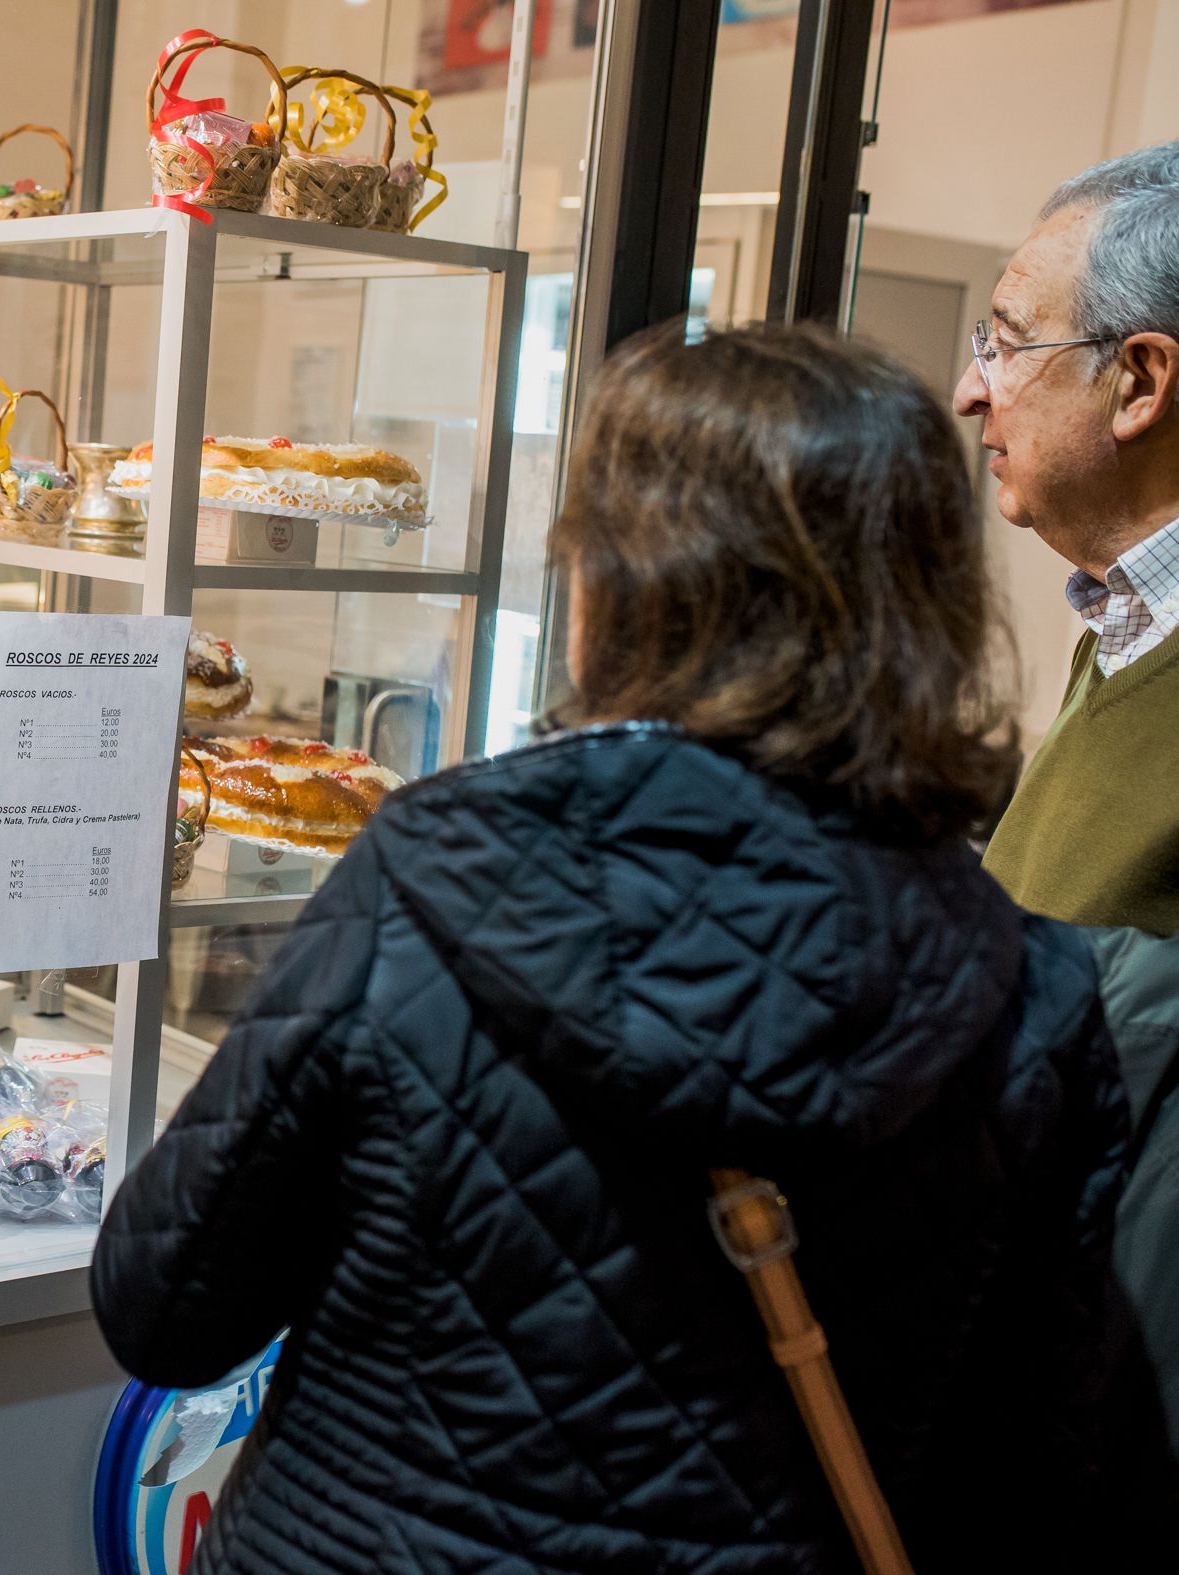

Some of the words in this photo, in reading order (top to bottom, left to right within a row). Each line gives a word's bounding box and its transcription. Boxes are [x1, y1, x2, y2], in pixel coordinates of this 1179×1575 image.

[6, 652, 61, 664] ROSCOS
[68, 653, 84, 664] DE
[90, 653, 129, 664] REYES
[133, 654, 159, 664] 2024
[0, 690, 36, 698] ROSCOS
[101, 708, 121, 717] Euros
[4, 818, 24, 826] Nata,
[52, 816, 73, 824] Cidra
[83, 815, 106, 823] Crema
[107, 813, 141, 822] Pastelera)
[92, 847, 111, 856] Euros
